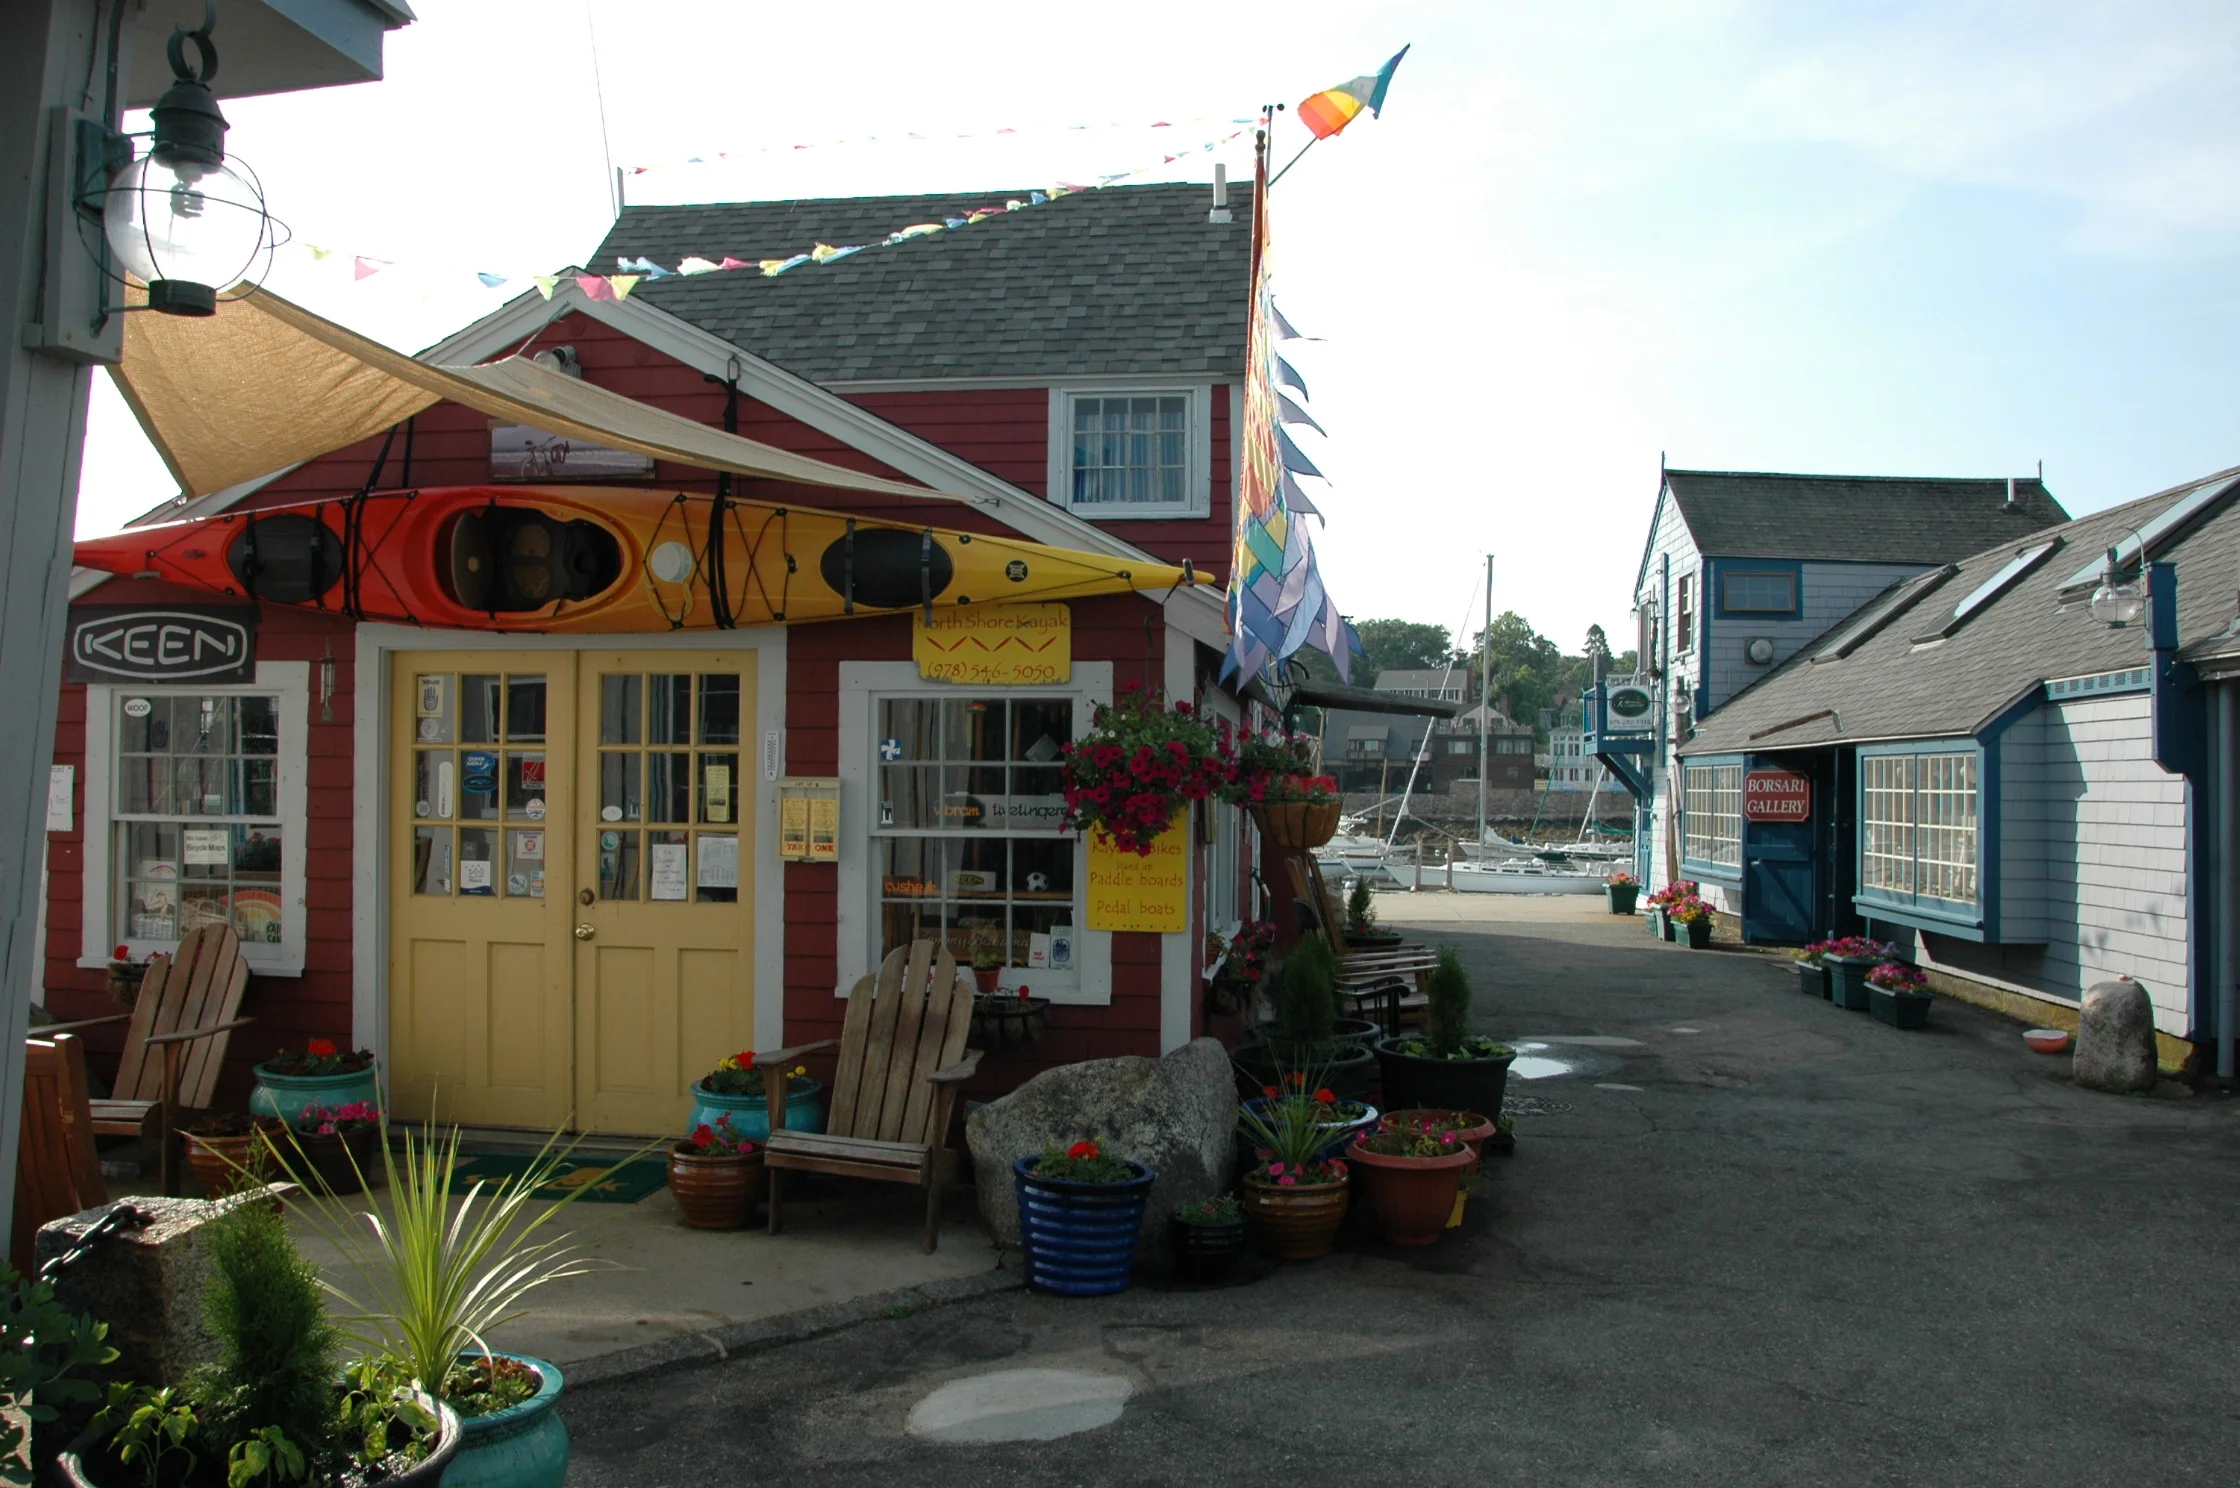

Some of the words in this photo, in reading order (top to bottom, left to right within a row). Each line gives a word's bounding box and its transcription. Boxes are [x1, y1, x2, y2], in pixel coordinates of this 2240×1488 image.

[965, 610, 1013, 629] Shore
[1016, 609, 1068, 636] Kayak
[84, 625, 236, 665] KEEN
[928, 661, 967, 679] (978)
[1748, 779, 1805, 793] BORSARI
[1747, 799, 1806, 814] GALLERY
[1090, 871, 1133, 887] Paddle
[1140, 872, 1184, 887] boards
[1096, 899, 1131, 915] Pedal
[1140, 900, 1176, 915] boats
